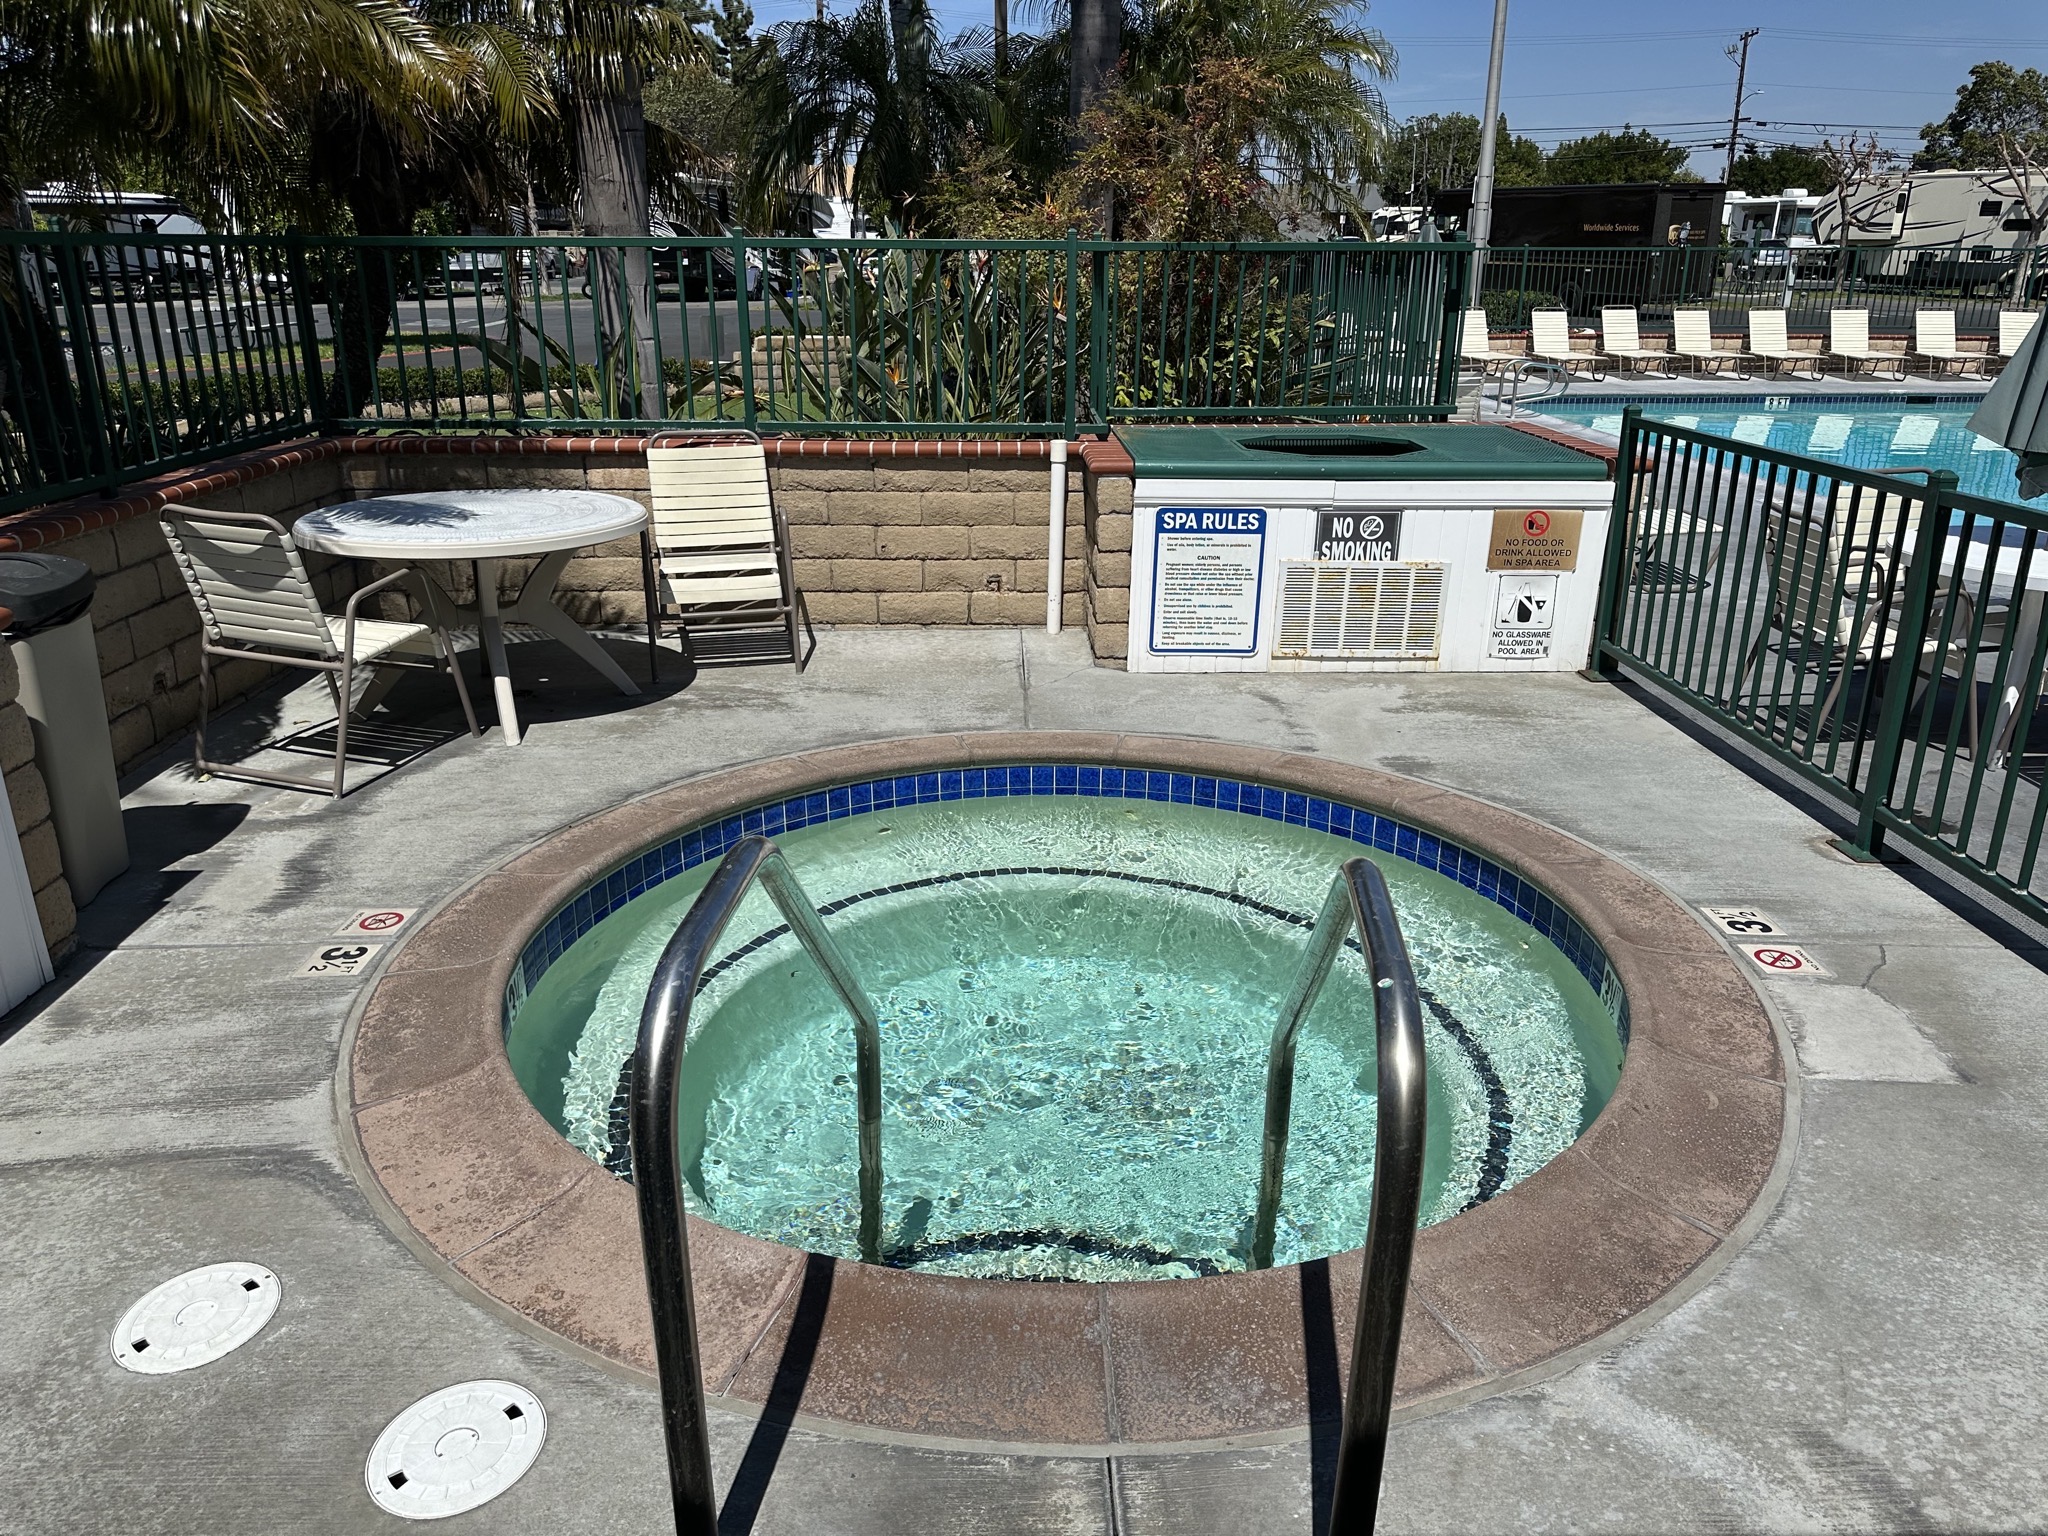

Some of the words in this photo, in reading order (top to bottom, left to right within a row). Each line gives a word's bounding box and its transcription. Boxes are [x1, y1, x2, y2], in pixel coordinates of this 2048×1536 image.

[1584, 224, 1613, 232] Worldwide
[1769, 398, 1774, 410] 8
[1778, 398, 1789, 408] FT
[1163, 512, 1198, 529] SPA
[1202, 512, 1260, 530] RULES
[1332, 517, 1354, 538] NO
[1321, 541, 1392, 560] SMOKING
